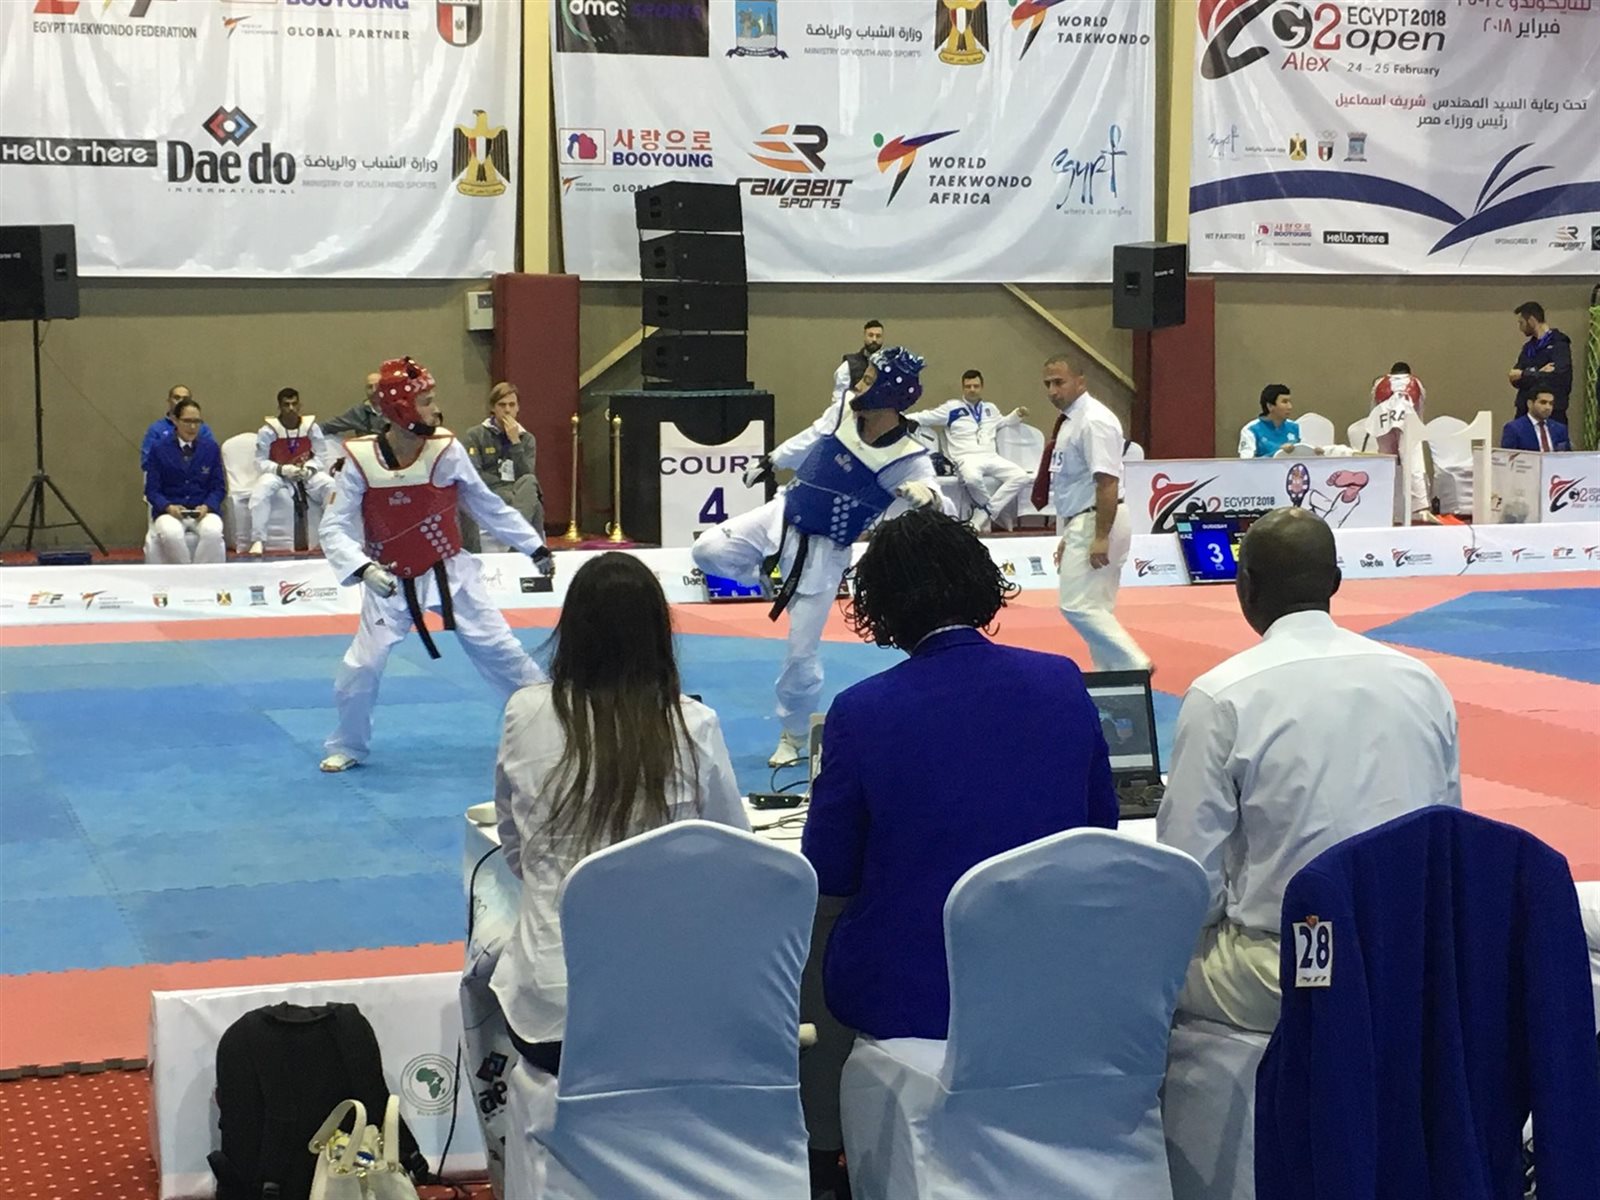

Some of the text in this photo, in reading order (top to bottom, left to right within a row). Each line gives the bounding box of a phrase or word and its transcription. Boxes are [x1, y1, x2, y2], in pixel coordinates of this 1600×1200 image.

[33, 21, 198, 39] EGYPT TAEKWONDO FEDERATION
[1057, 15, 1108, 28] WORLD
[1515, 18, 1560, 39] فبراير
[287, 26, 343, 38] GLOBAL
[349, 28, 410, 41] PARTNER
[805, 24, 923, 42] وزارة الشباب والرياضة
[1057, 32, 1151, 45] TAEKWONDO
[1346, 28, 1446, 56] open
[1281, 52, 1331, 72] Alex
[1347, 63, 1362, 73] 24
[1375, 63, 1390, 74] 25
[1393, 65, 1440, 78] February
[1335, 93, 1587, 113] تحت رعاية السيد المهندس شريف اسماعيل
[1417, 115, 1508, 130] رئيس وزراء مصر
[613, 128, 713, 151] 사랑으로
[2, 140, 149, 164] Hello There
[612, 151, 714, 168] BOOYOUNG
[303, 154, 438, 173] وزارة الشباب والرياضة
[929, 156, 986, 169] WORLD
[929, 175, 1032, 188] TAEKWONDO
[929, 193, 991, 205] AFRICA
[1326, 232, 1386, 243] Hello There
[699, 487, 729, 525] 4
[1207, 542, 1224, 564] 3
[1298, 925, 1330, 970] 28
